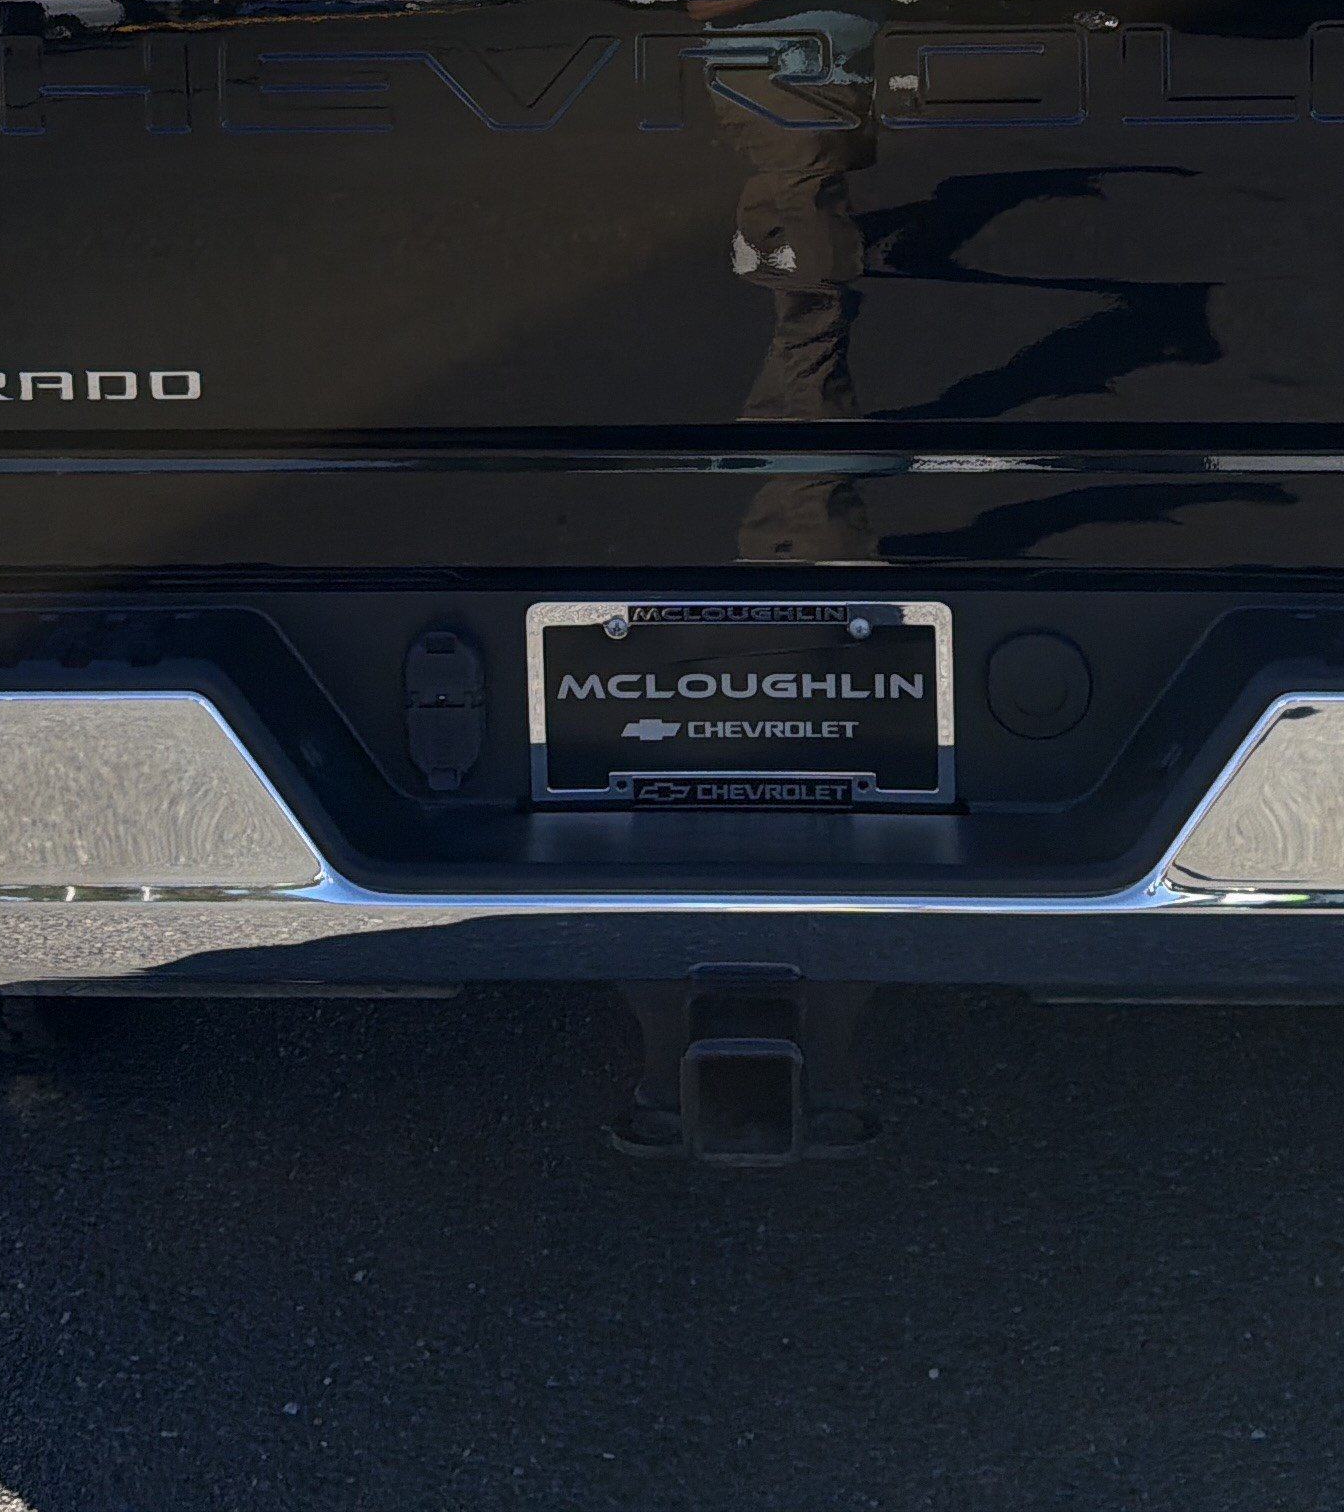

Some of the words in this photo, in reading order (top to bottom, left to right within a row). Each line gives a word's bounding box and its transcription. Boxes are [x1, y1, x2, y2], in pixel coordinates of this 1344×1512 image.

[631, 606, 846, 623] MCLOUGHLIN
[556, 673, 924, 700] MCLOUGHLIN
[687, 721, 860, 738] CHEVROLET
[696, 784, 848, 801] CHEVROLET
